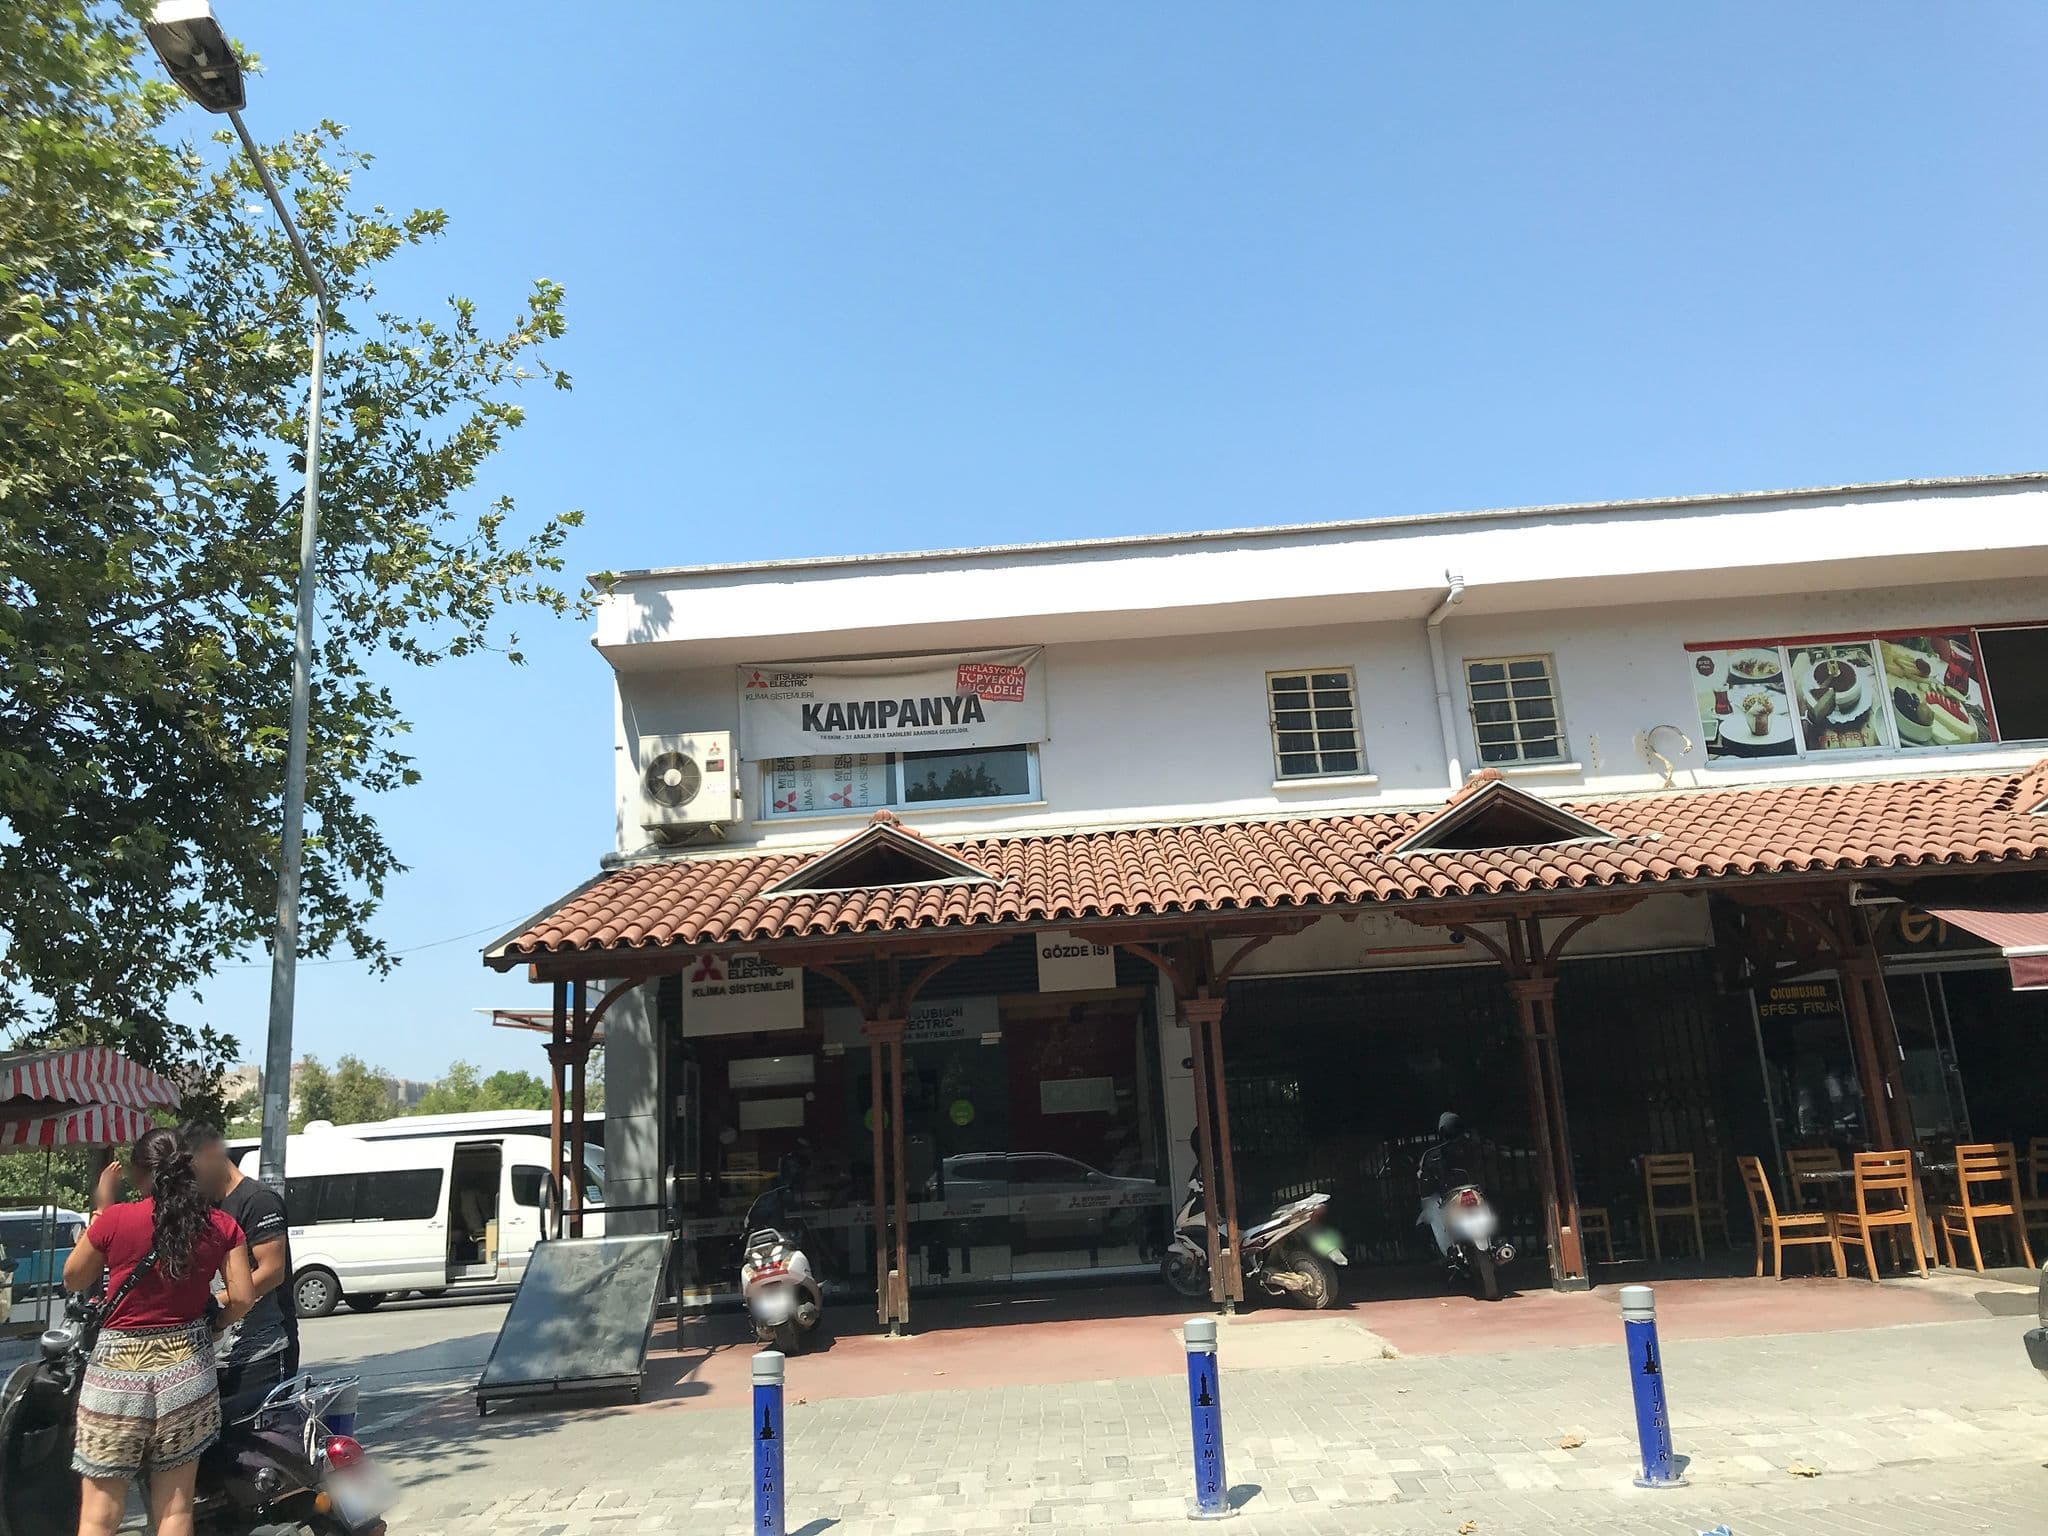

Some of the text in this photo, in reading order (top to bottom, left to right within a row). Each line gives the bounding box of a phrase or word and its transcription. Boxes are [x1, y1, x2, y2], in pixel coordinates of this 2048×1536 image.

[960, 664, 1025, 676] ENFLASYONLA
[769, 679, 808, 688] ELECTRIC
[770, 689, 815, 700] SİSTEMLERİ
[801, 693, 986, 732] KAMPANYA
[1042, 944, 1089, 959] GÖZDE
[727, 966, 784, 980] ELECTRIC
[692, 979, 794, 998] KLİMA SİSTEMLERİ
[1760, 1002, 1798, 1016] EFES
